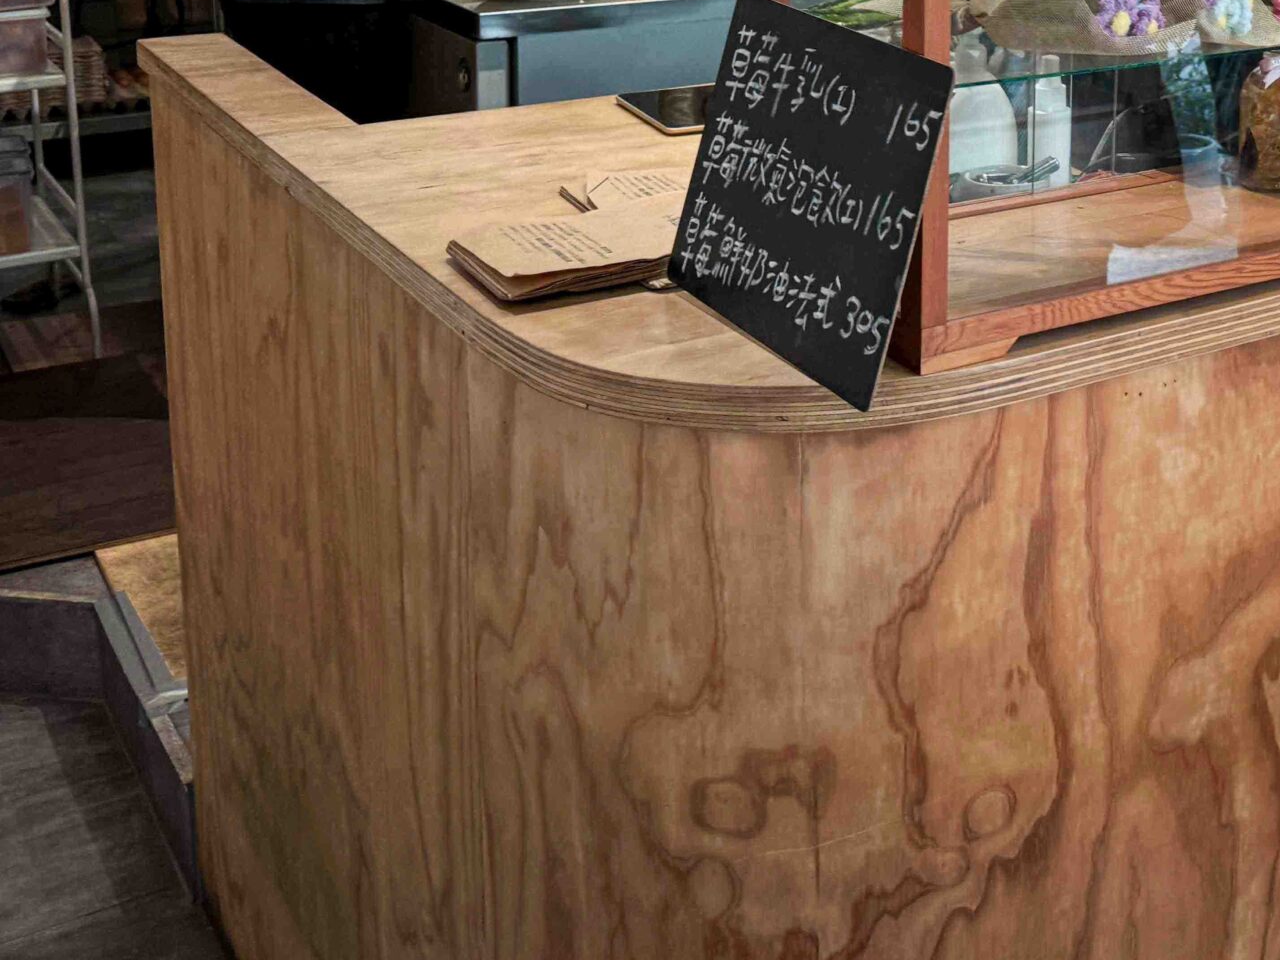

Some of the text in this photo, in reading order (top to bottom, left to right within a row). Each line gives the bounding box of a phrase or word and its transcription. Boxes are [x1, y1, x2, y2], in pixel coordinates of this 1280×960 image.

[885, 99, 944, 152] 165
[863, 190, 916, 251] 165
[840, 296, 890, 356] 305
